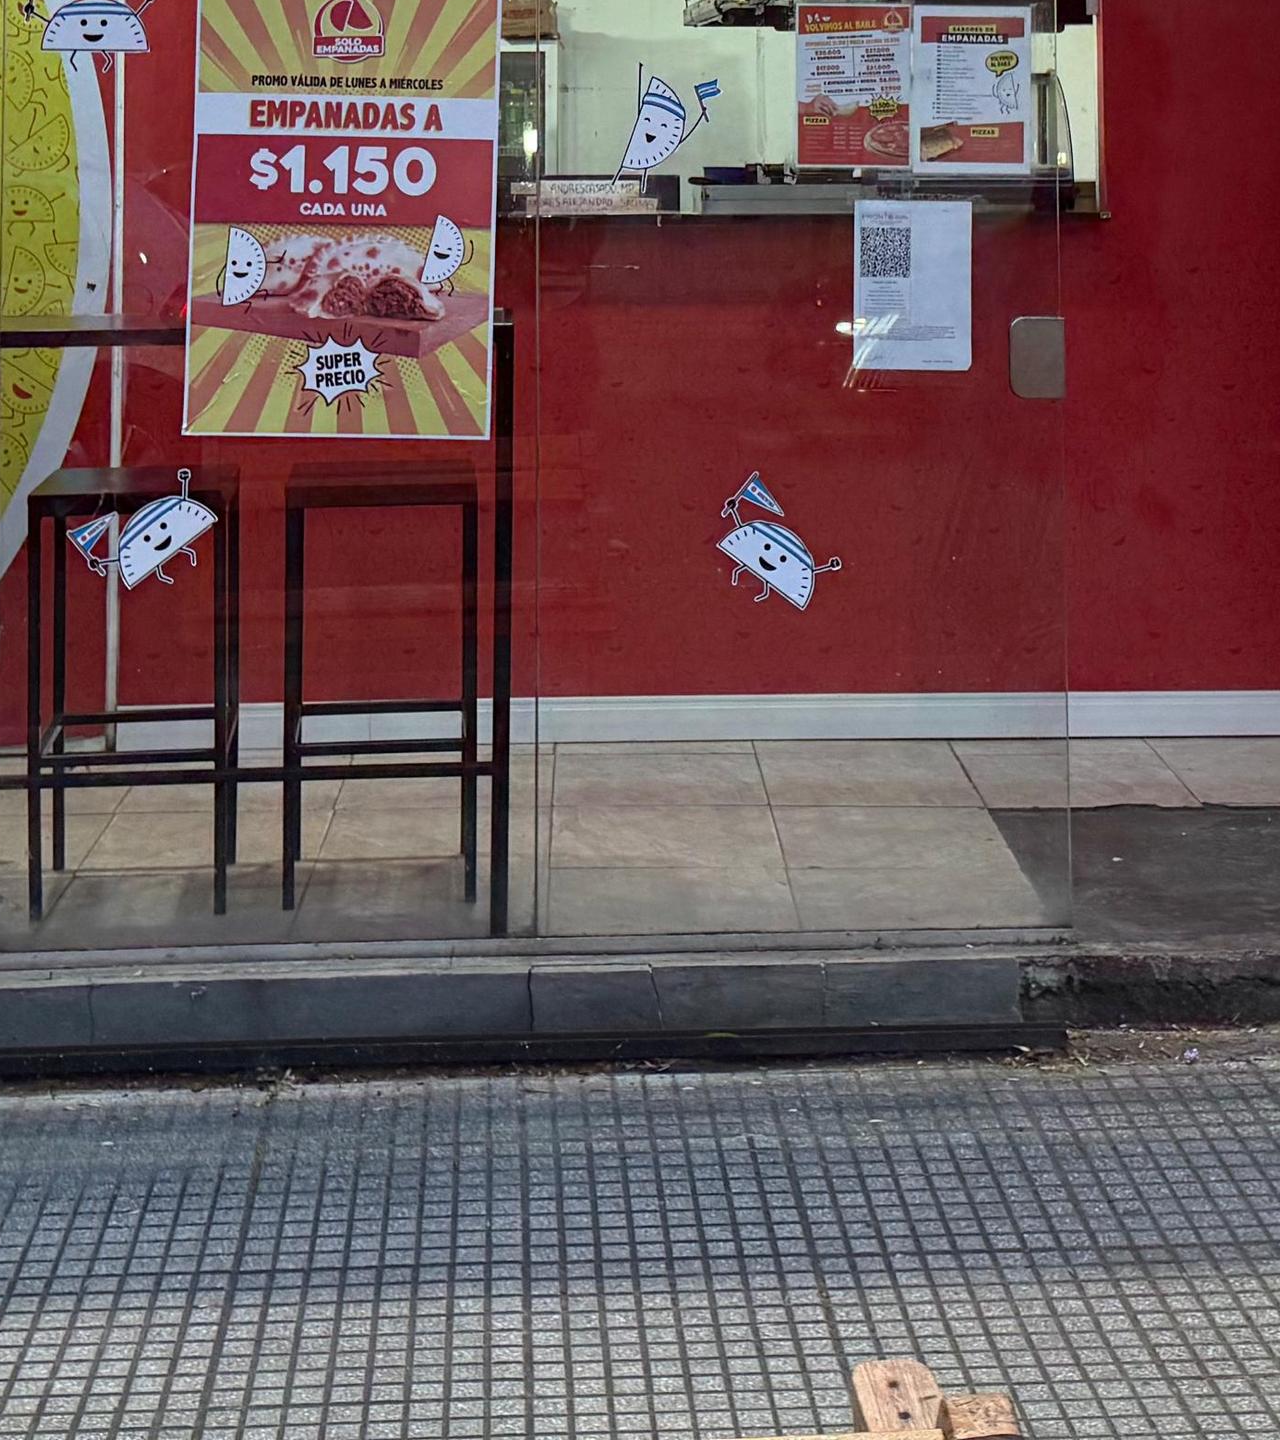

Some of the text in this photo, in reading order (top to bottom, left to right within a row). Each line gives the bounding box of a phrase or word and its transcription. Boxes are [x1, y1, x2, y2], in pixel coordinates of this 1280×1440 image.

[334, 38, 363, 47] SOLO
[941, 34, 1004, 43] EMPANADAS
[316, 43, 380, 54] EMPANADAS
[251, 74, 443, 90] PROMO VÁLIDA DE LUNES A MIÉRCOLES
[249, 100, 444, 132] EMPANADAS A
[249, 144, 437, 197] $1.150
[299, 202, 388, 217] CADA UNA
[316, 352, 362, 371] SUPER
[315, 369, 366, 388] PRECIO
